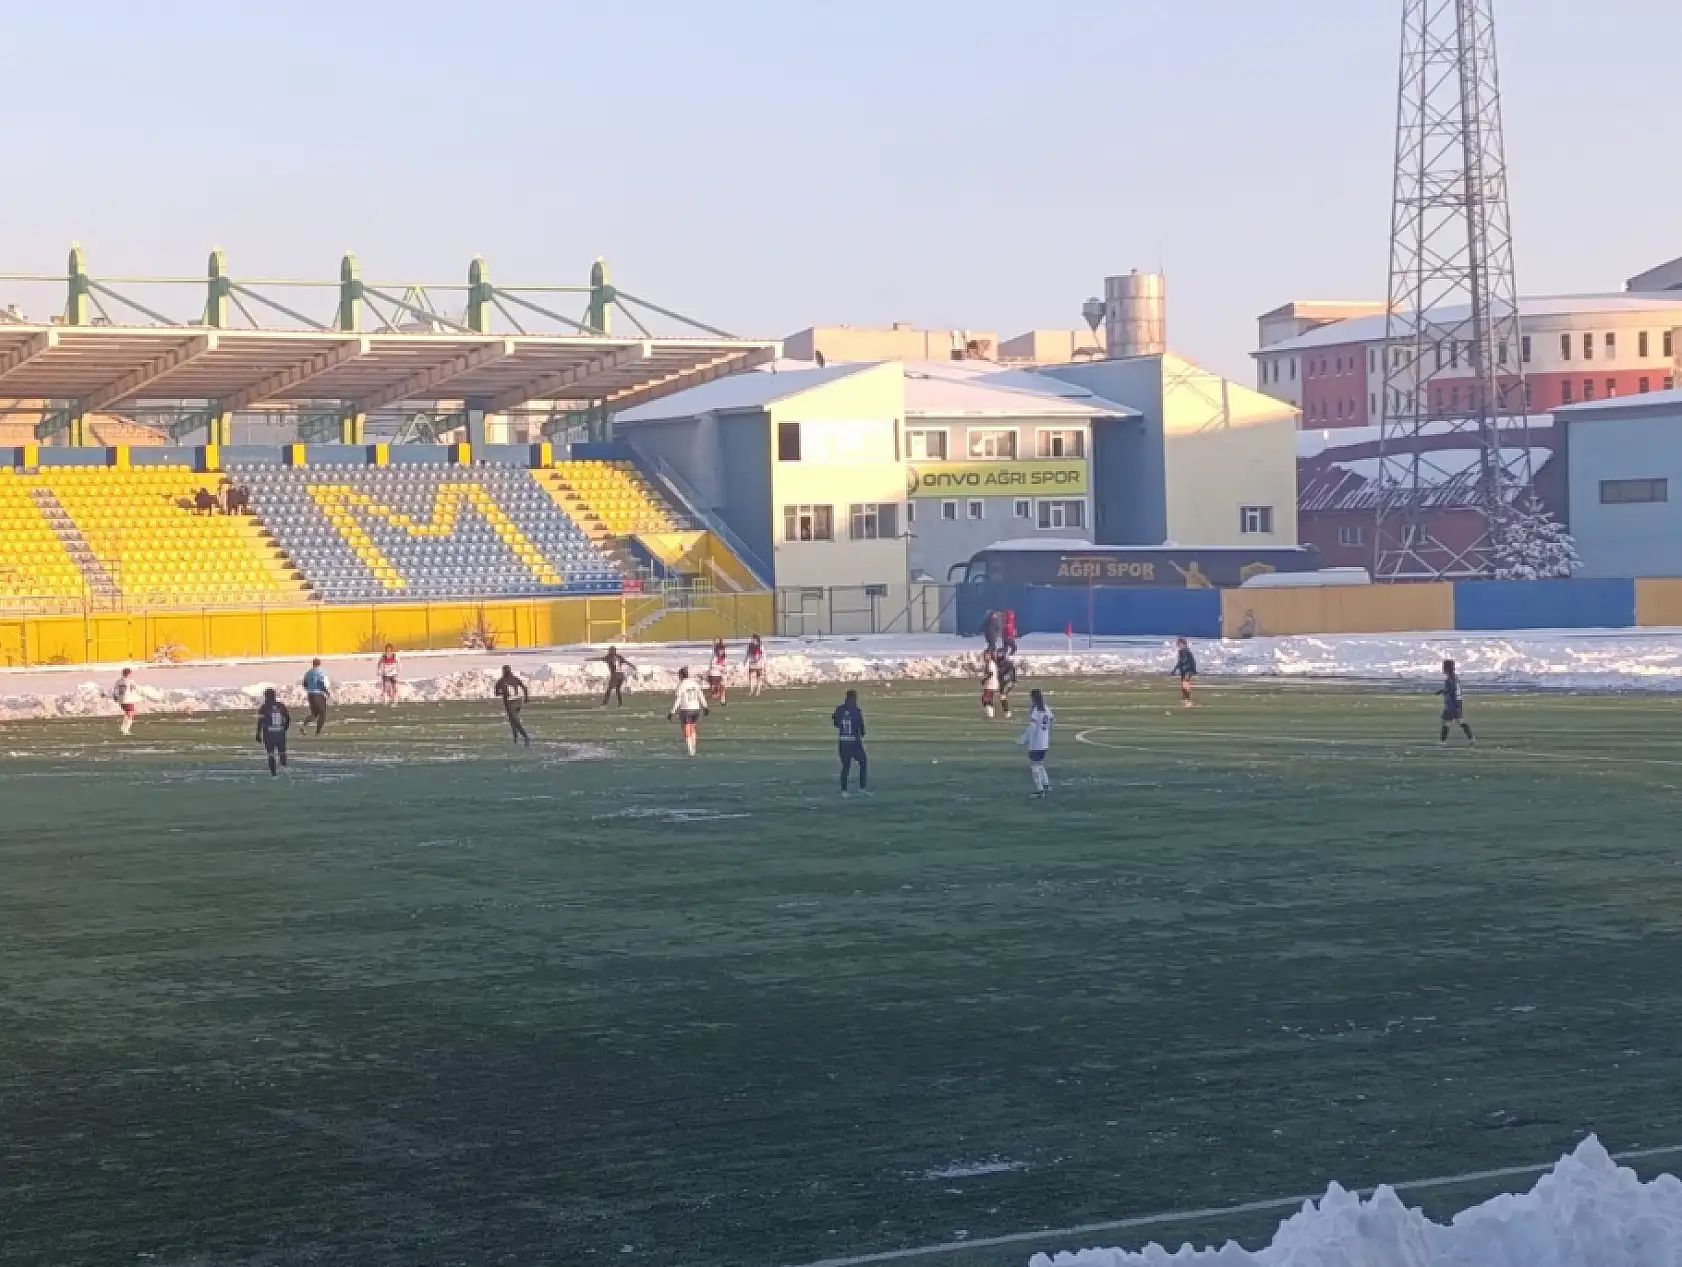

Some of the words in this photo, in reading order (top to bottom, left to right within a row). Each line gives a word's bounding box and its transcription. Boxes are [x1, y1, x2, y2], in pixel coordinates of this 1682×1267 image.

[985, 469, 1026, 485] AĞRI
[1030, 470, 1081, 484] SPOR
[1057, 560, 1100, 576] AĞRI
[1107, 562, 1154, 577] SPOR
